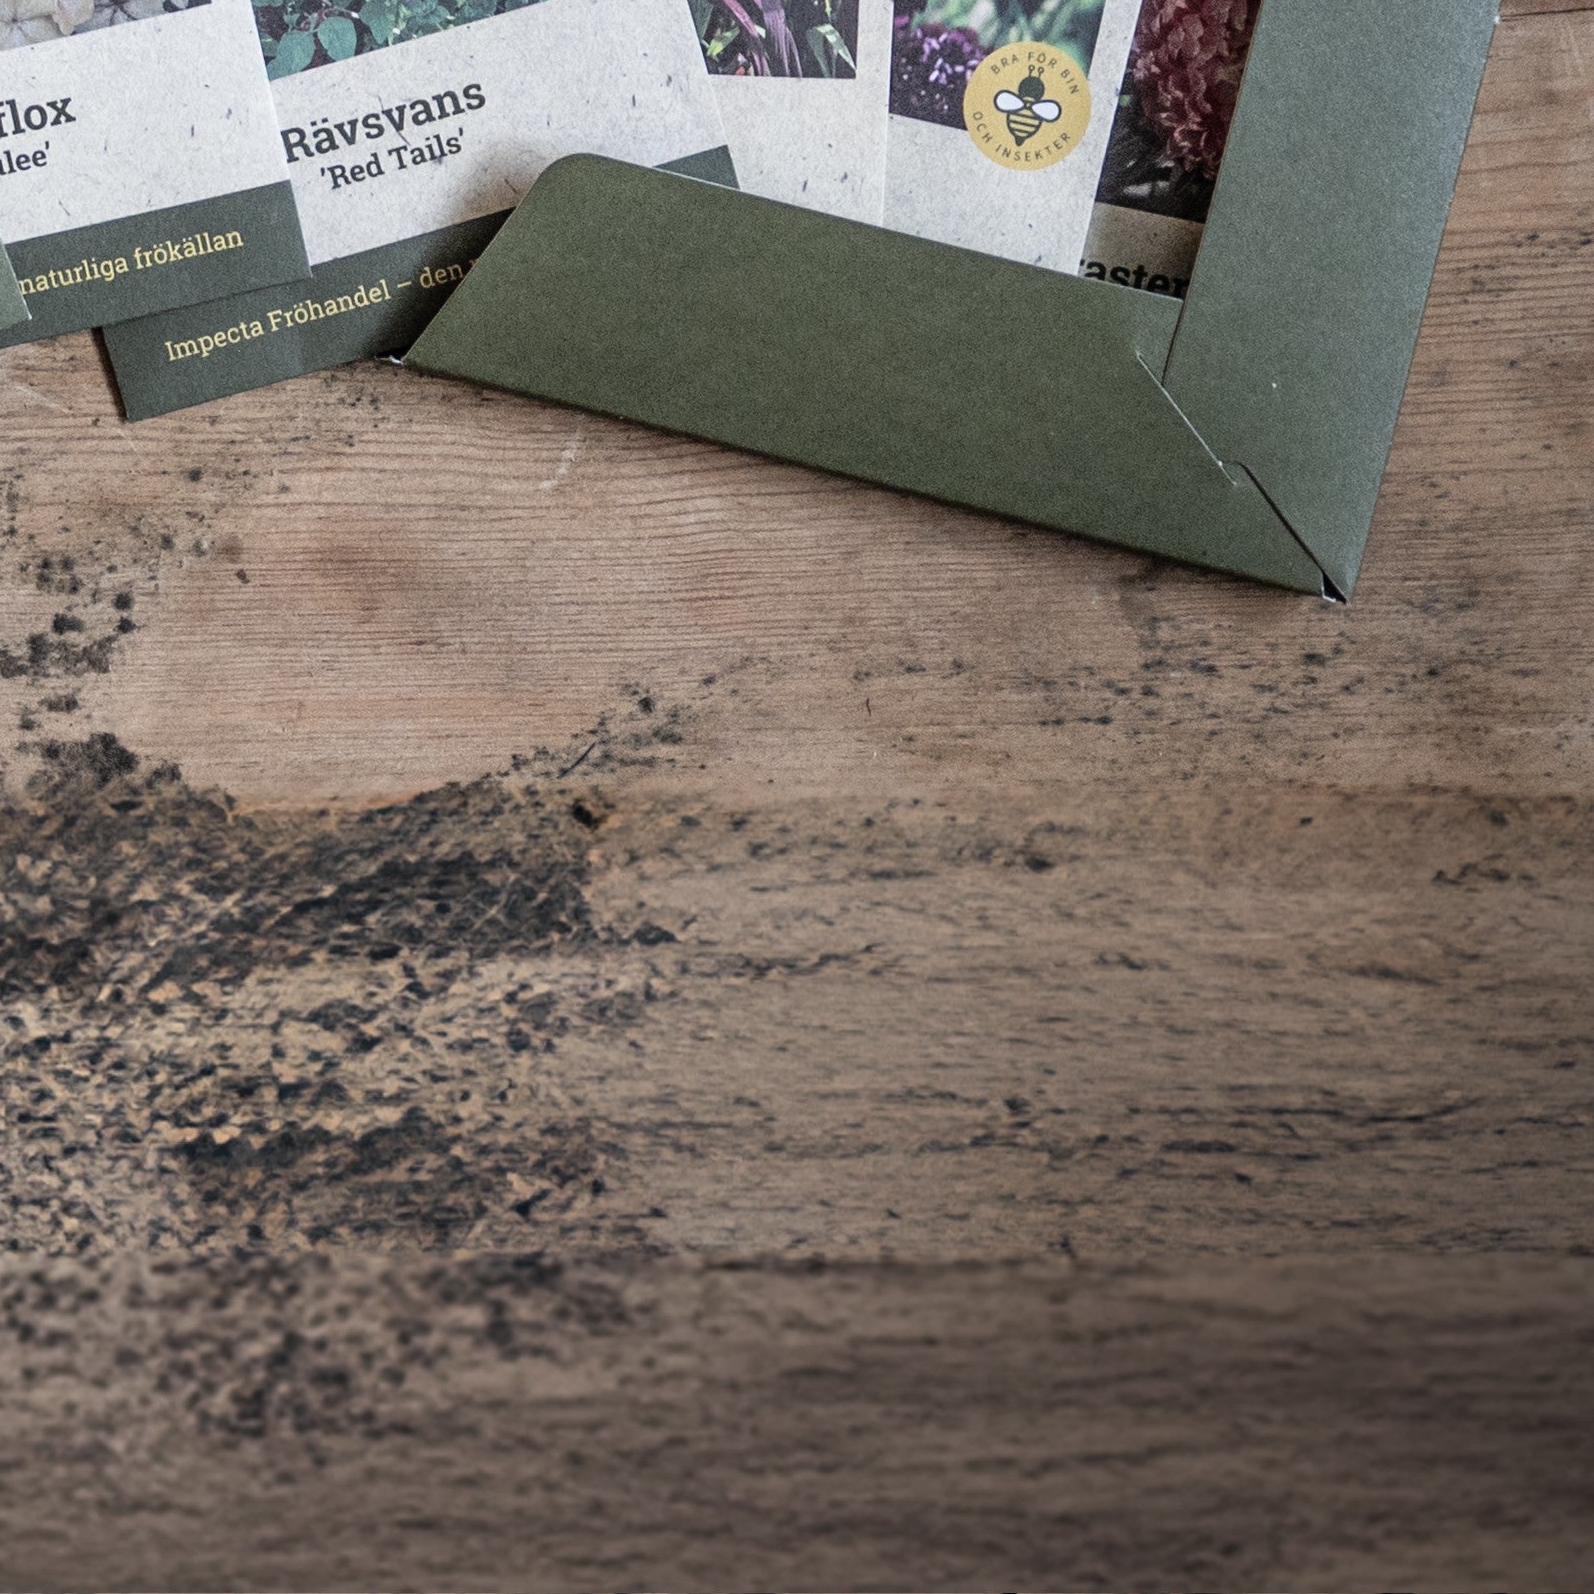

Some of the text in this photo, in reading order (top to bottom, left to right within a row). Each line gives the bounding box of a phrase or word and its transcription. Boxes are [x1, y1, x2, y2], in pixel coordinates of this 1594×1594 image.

[991, 54, 1019, 75] BRA
[1061, 69, 1079, 95] BIN
[280, 83, 486, 164] Rävsvans
[973, 111, 993, 143] OCH
[995, 132, 1071, 162] INSEKTER
[320, 127, 464, 191] 'Red Tails'
[17, 230, 244, 297] naturliga frökällan
[163, 320, 265, 362] Impecta
[266, 278, 392, 333] Fröhandel
[419, 263, 464, 289] den
